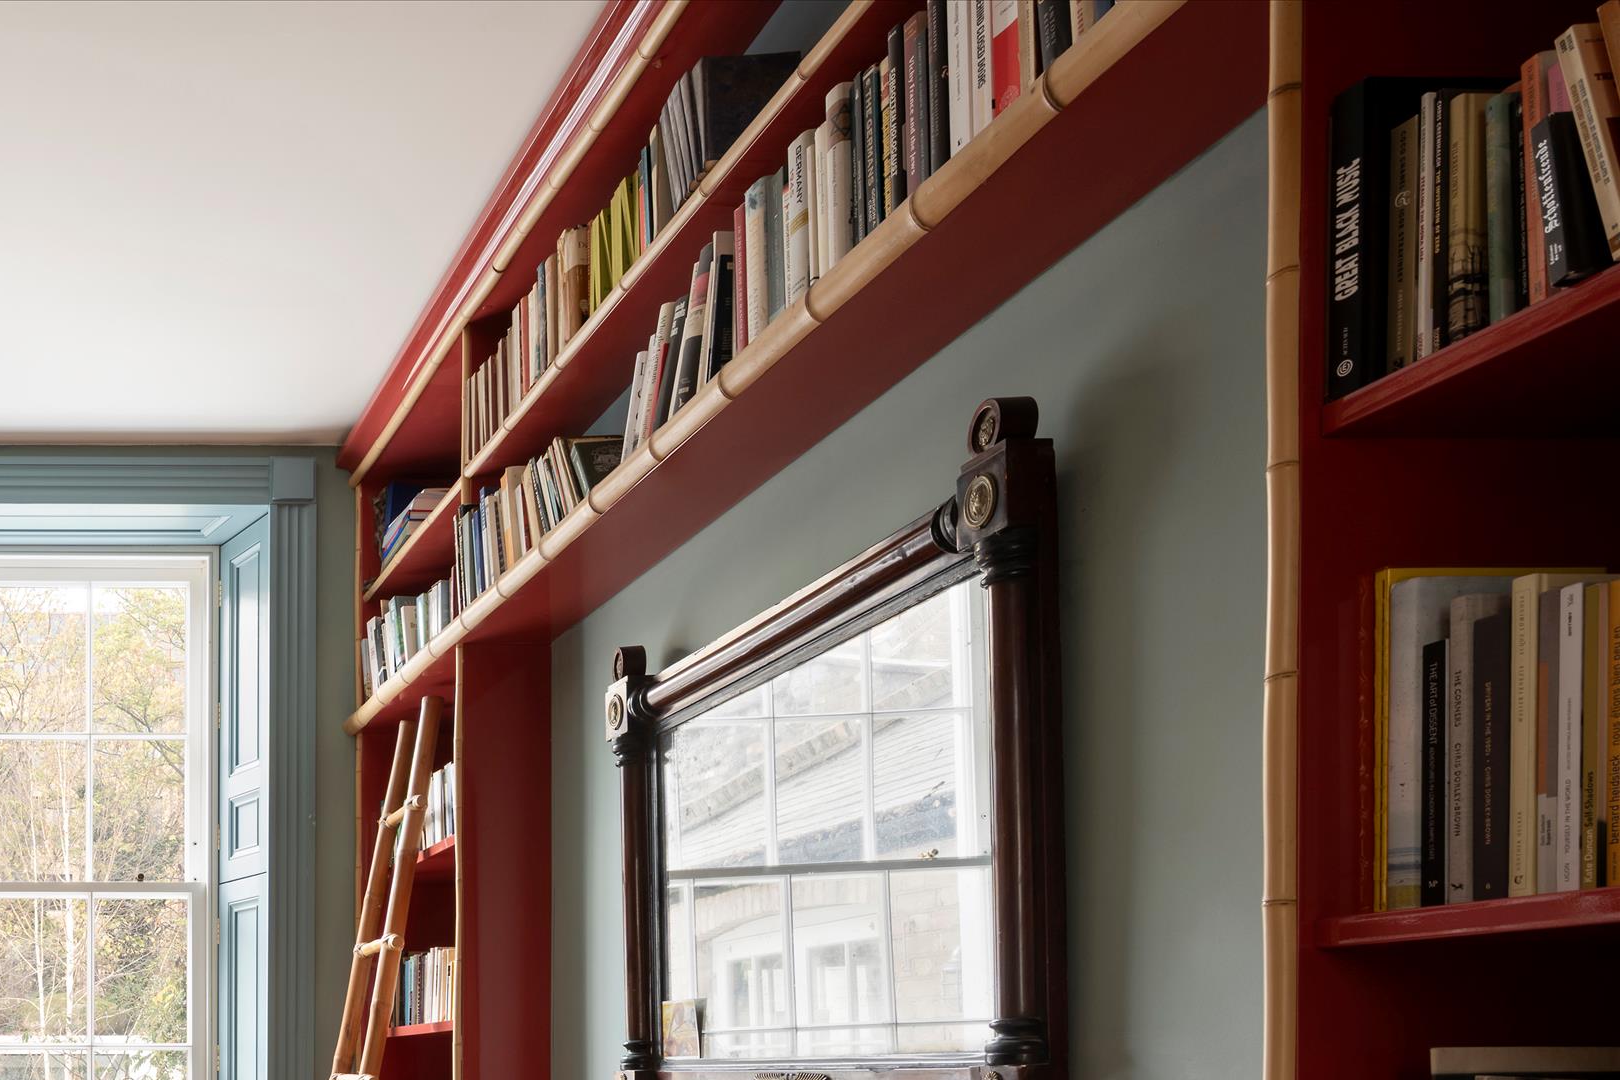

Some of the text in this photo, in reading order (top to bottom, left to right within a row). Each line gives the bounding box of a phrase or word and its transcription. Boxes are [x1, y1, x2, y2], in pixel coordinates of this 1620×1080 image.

[976, 26, 986, 59] CLOSED
[908, 55, 916, 83] Vichy
[977, 59, 986, 90] DOORS
[908, 84, 916, 114] France
[865, 87, 875, 187] THE GERMANS
[890, 123, 898, 178] HOLOCAUST
[1399, 130, 1407, 155] COCO
[795, 144, 803, 204] GERMANY
[908, 152, 917, 176] Jews
[1398, 156, 1407, 190] CHANEL
[1535, 138, 1560, 234] Schottenfreude
[1334, 156, 1361, 301] GREAT BLACK MUSIC
[1398, 208, 1406, 230] IGOR
[1428, 661, 1438, 682] THE
[1428, 682, 1438, 699] ART
[1429, 698, 1437, 708] of
[1484, 680, 1492, 712] DRIVERS
[1428, 708, 1438, 745] DISSENT
[1484, 712, 1492, 721] IN
[1484, 722, 1492, 736] THE
[1612, 721, 1620, 746] nous
[1453, 670, 1462, 837] THE CORNERS CHRIS DORLEY-BROWN
[1484, 766, 1492, 788] CHRIS
[1608, 754, 1620, 802] heidsieck
[1584, 771, 1594, 883] Kate Duncan Self-Shadows
[1608, 804, 1620, 845] bernard
